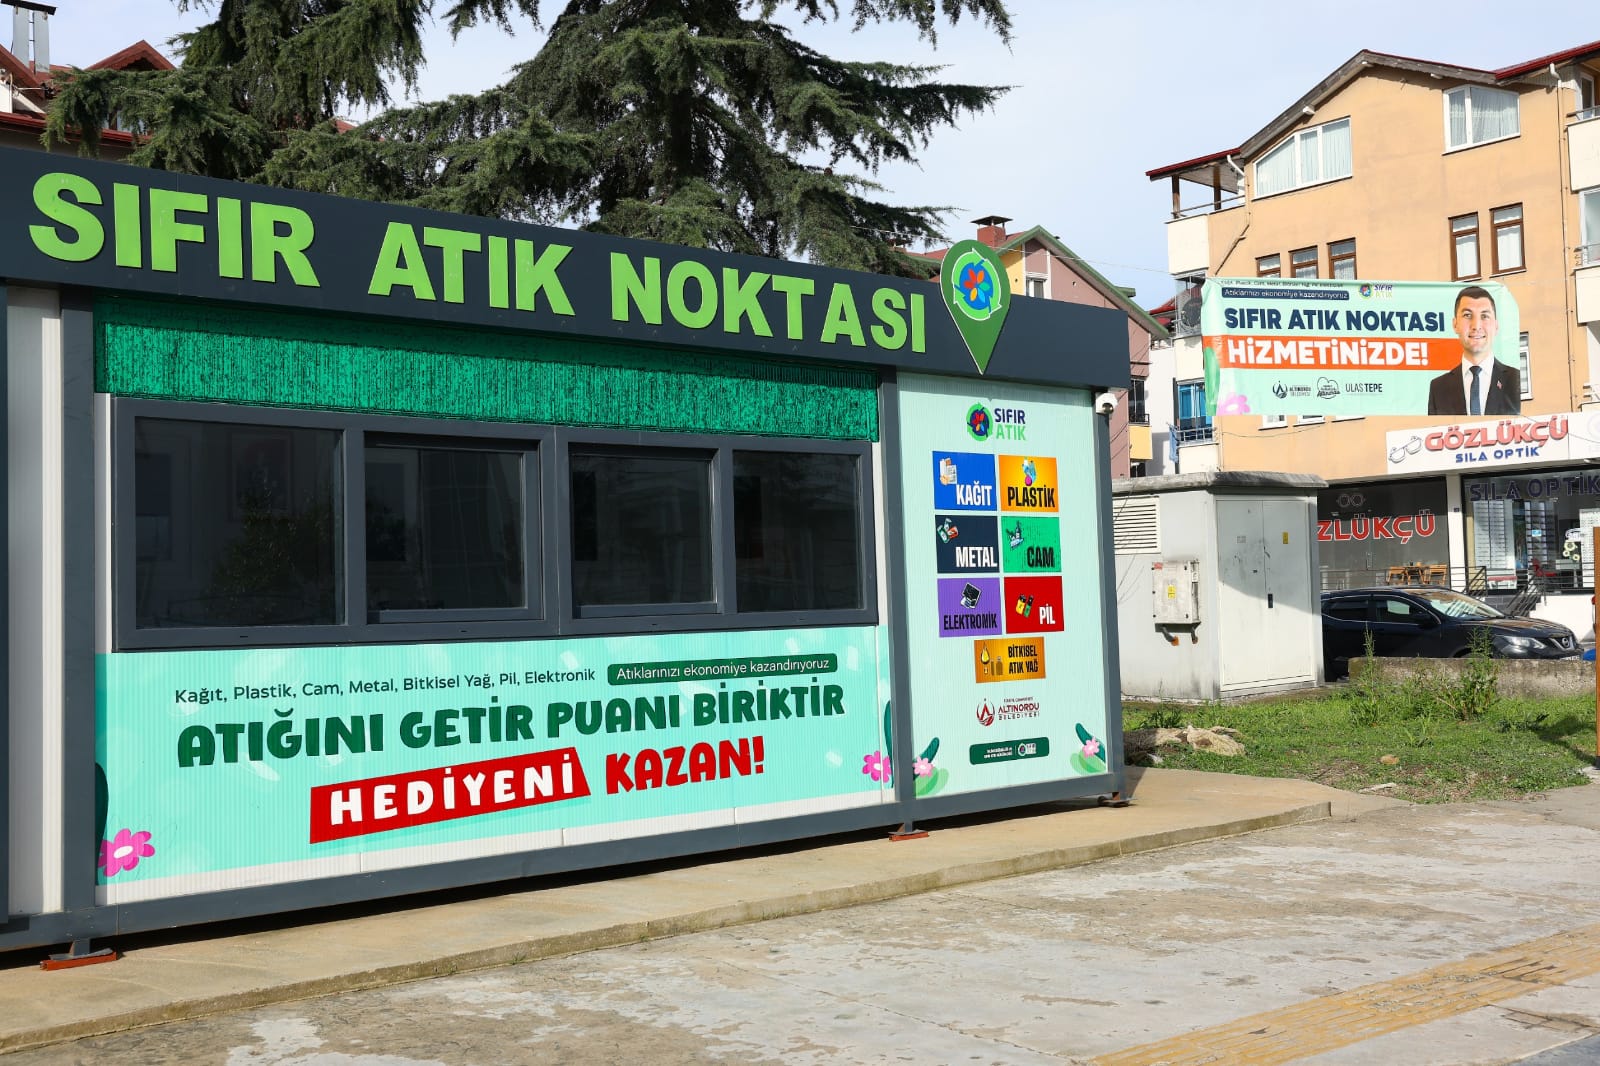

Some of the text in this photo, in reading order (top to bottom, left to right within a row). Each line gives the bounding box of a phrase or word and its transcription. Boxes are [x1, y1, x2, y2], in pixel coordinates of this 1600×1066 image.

[29, 172, 926, 353] SIFIR ATIK NOKTASI
[1224, 308, 1445, 331] SIFIR ATIK NOKTASI
[1227, 337, 1429, 366] HİZMETİNİZDE!
[1364, 383, 1383, 393] TEPE
[995, 408, 1026, 424] SIFIR
[996, 425, 1026, 441] ATIK
[1425, 415, 1569, 451] GÖZLÜKÇÜ
[1455, 447, 1540, 463] SILA OPTİK
[955, 480, 992, 506] KAĞIT
[1007, 484, 1056, 508] PLASTİK
[955, 546, 997, 568] METAL
[1027, 546, 1055, 568] CAM
[1039, 604, 1056, 625] PİL
[616, 658, 830, 680] Atıklarınızı ekonomiye kazandırıyoruz
[1009, 658, 1039, 674] ATIK YAĞ
[175, 668, 596, 705] Kağıt, Plastik, Cam, Metal, Bitkisel Yağ, Pil, Elektronik
[997, 702, 1040, 714] ALTINORDU
[177, 676, 846, 768] ATIĞINI GETİR PUANI BİRİKTİR
[329, 735, 765, 826] HEDİYENİ KAZAN!
